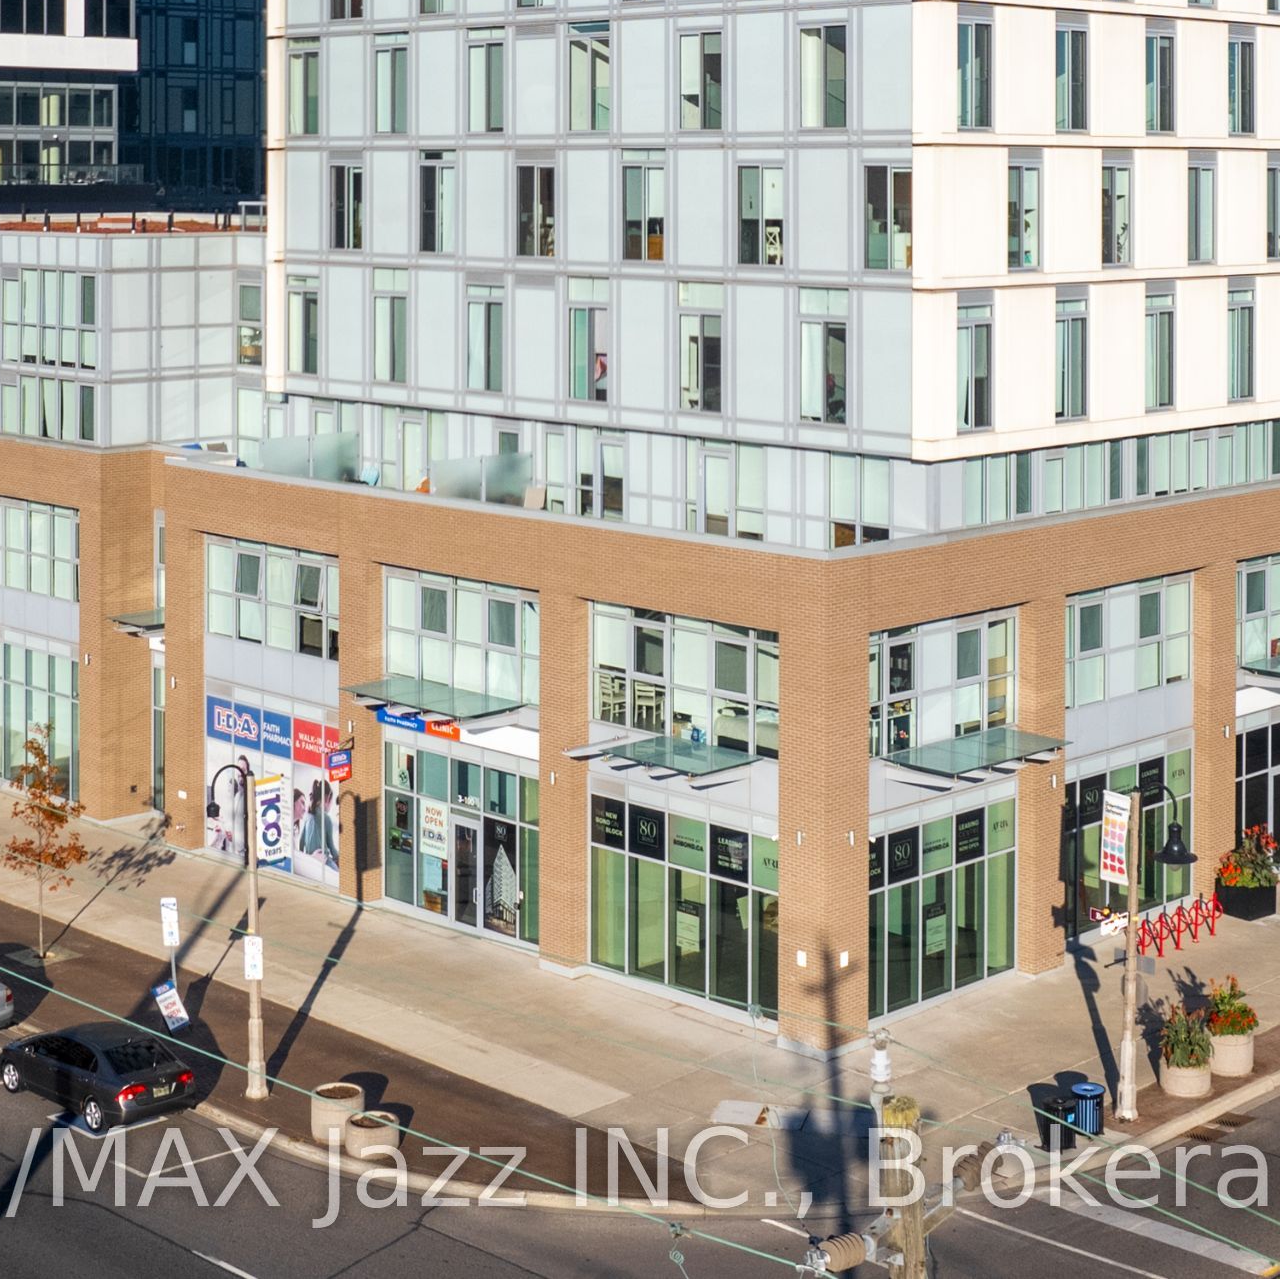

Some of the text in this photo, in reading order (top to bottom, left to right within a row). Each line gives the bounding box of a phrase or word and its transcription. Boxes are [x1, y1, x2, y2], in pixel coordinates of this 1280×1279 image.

[263, 722, 280, 734] FAITH
[298, 732, 324, 746] WALK-IN
[424, 805, 443, 818] NOW
[605, 811, 618, 821] NEW
[424, 815, 444, 828] OPEN
[595, 816, 611, 826] BOND
[605, 827, 623, 837] BLOCK
[639, 819, 657, 839] 80
[717, 836, 743, 850] LEASING
[264, 846, 282, 857] Years
[894, 842, 910, 862] 80
